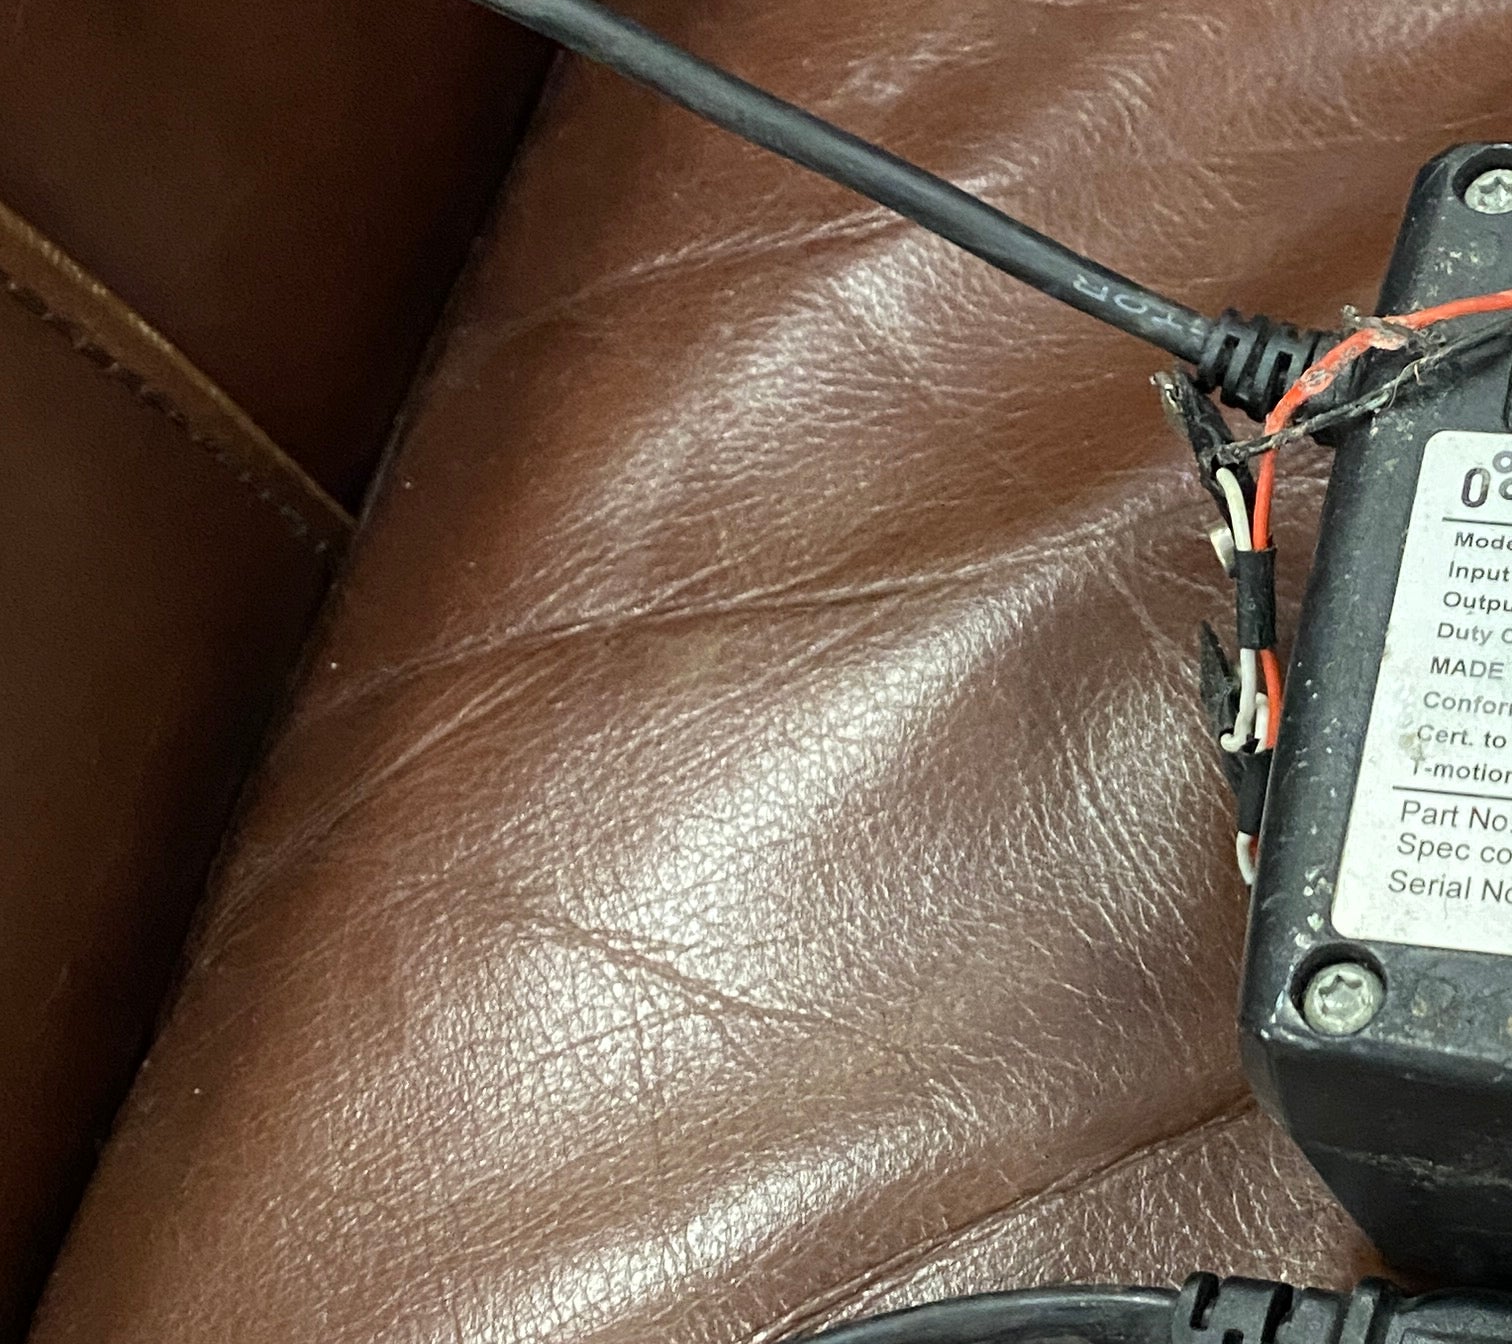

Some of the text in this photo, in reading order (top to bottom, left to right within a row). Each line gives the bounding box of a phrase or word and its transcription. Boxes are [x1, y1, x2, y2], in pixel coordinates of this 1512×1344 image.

[1449, 561, 1510, 583] Input
[1437, 622, 1493, 645] Duty
[1430, 657, 1504, 681] MADE
[1416, 724, 1473, 747] Cert.
[1484, 730, 1507, 749] to
[1401, 800, 1459, 828] Part
[1397, 832, 1470, 862] Spec
[1388, 869, 1472, 900] Serial
